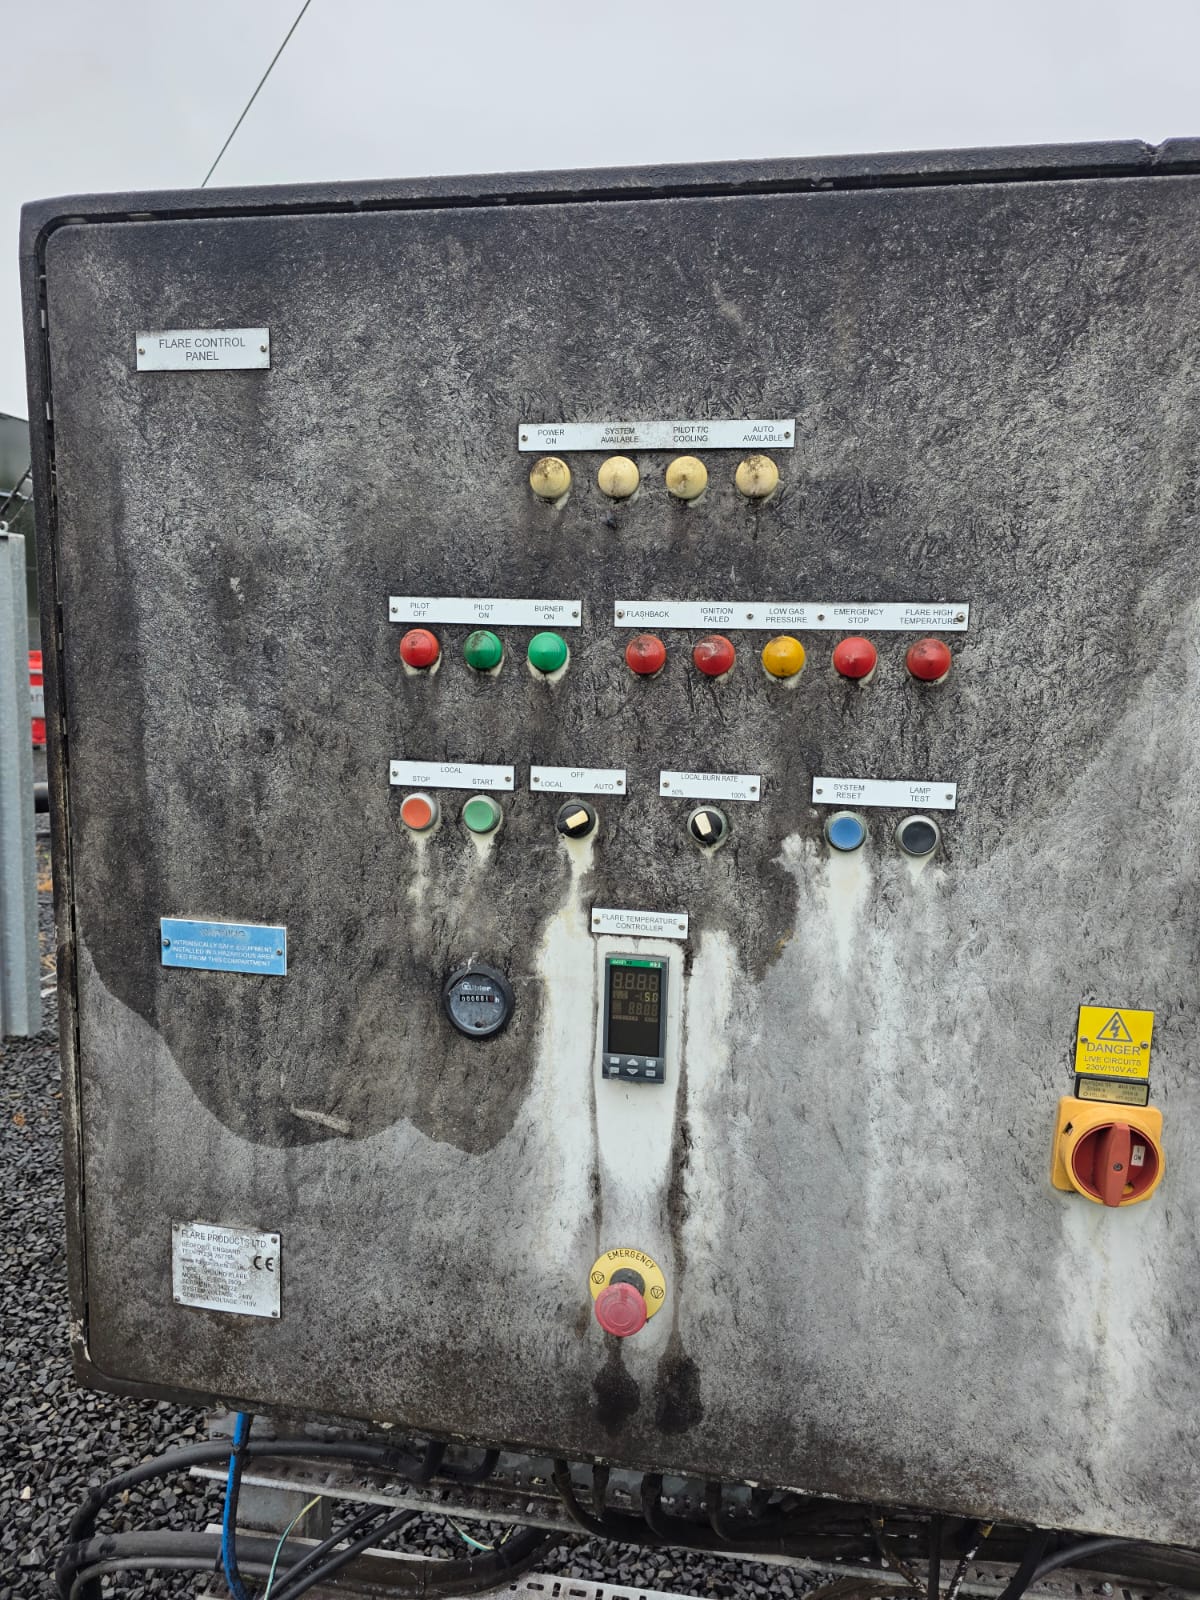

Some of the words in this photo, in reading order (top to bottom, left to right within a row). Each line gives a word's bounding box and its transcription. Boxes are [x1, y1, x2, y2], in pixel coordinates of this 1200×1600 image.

[159, 338, 192, 348] FLARE
[194, 337, 246, 347] CONTROL
[186, 351, 219, 361] PANEL
[538, 429, 565, 437] POWER
[605, 427, 635, 435] SYSTEM
[673, 426, 695, 434] PILOT
[601, 435, 639, 443] AVAILABLE
[673, 434, 708, 442] COOLING
[742, 434, 783, 442] AVAILABLE
[626, 610, 670, 618] FLASHBACK
[700, 607, 734, 615] IGNITION
[788, 608, 805, 616] GAS
[834, 608, 883, 616] EMERGENCY
[931, 609, 953, 617] HIGH
[703, 615, 730, 623] FAILED
[765, 616, 807, 624] PRESSURE
[848, 616, 870, 624] STOP
[900, 617, 958, 625] TEMPERATURE
[440, 766, 462, 774] LOCAL
[833, 783, 865, 791] SYSTEM
[909, 786, 932, 794] LAMP
[836, 792, 861, 800] RESET
[910, 794, 930, 802] TEST
[626, 915, 677, 925] TEMPERATURE
[616, 924, 663, 932] CONTROLLER
[1086, 1042, 1140, 1056] DANGER
[1104, 1057, 1141, 1067] CIRCUITS
[1086, 1064, 1126, 1073] 230V/110V
[208, 1234, 250, 1248] PRODUCTS
[607, 1249, 656, 1270] EMERGENCY
[253, 1256, 274, 1272] CE
